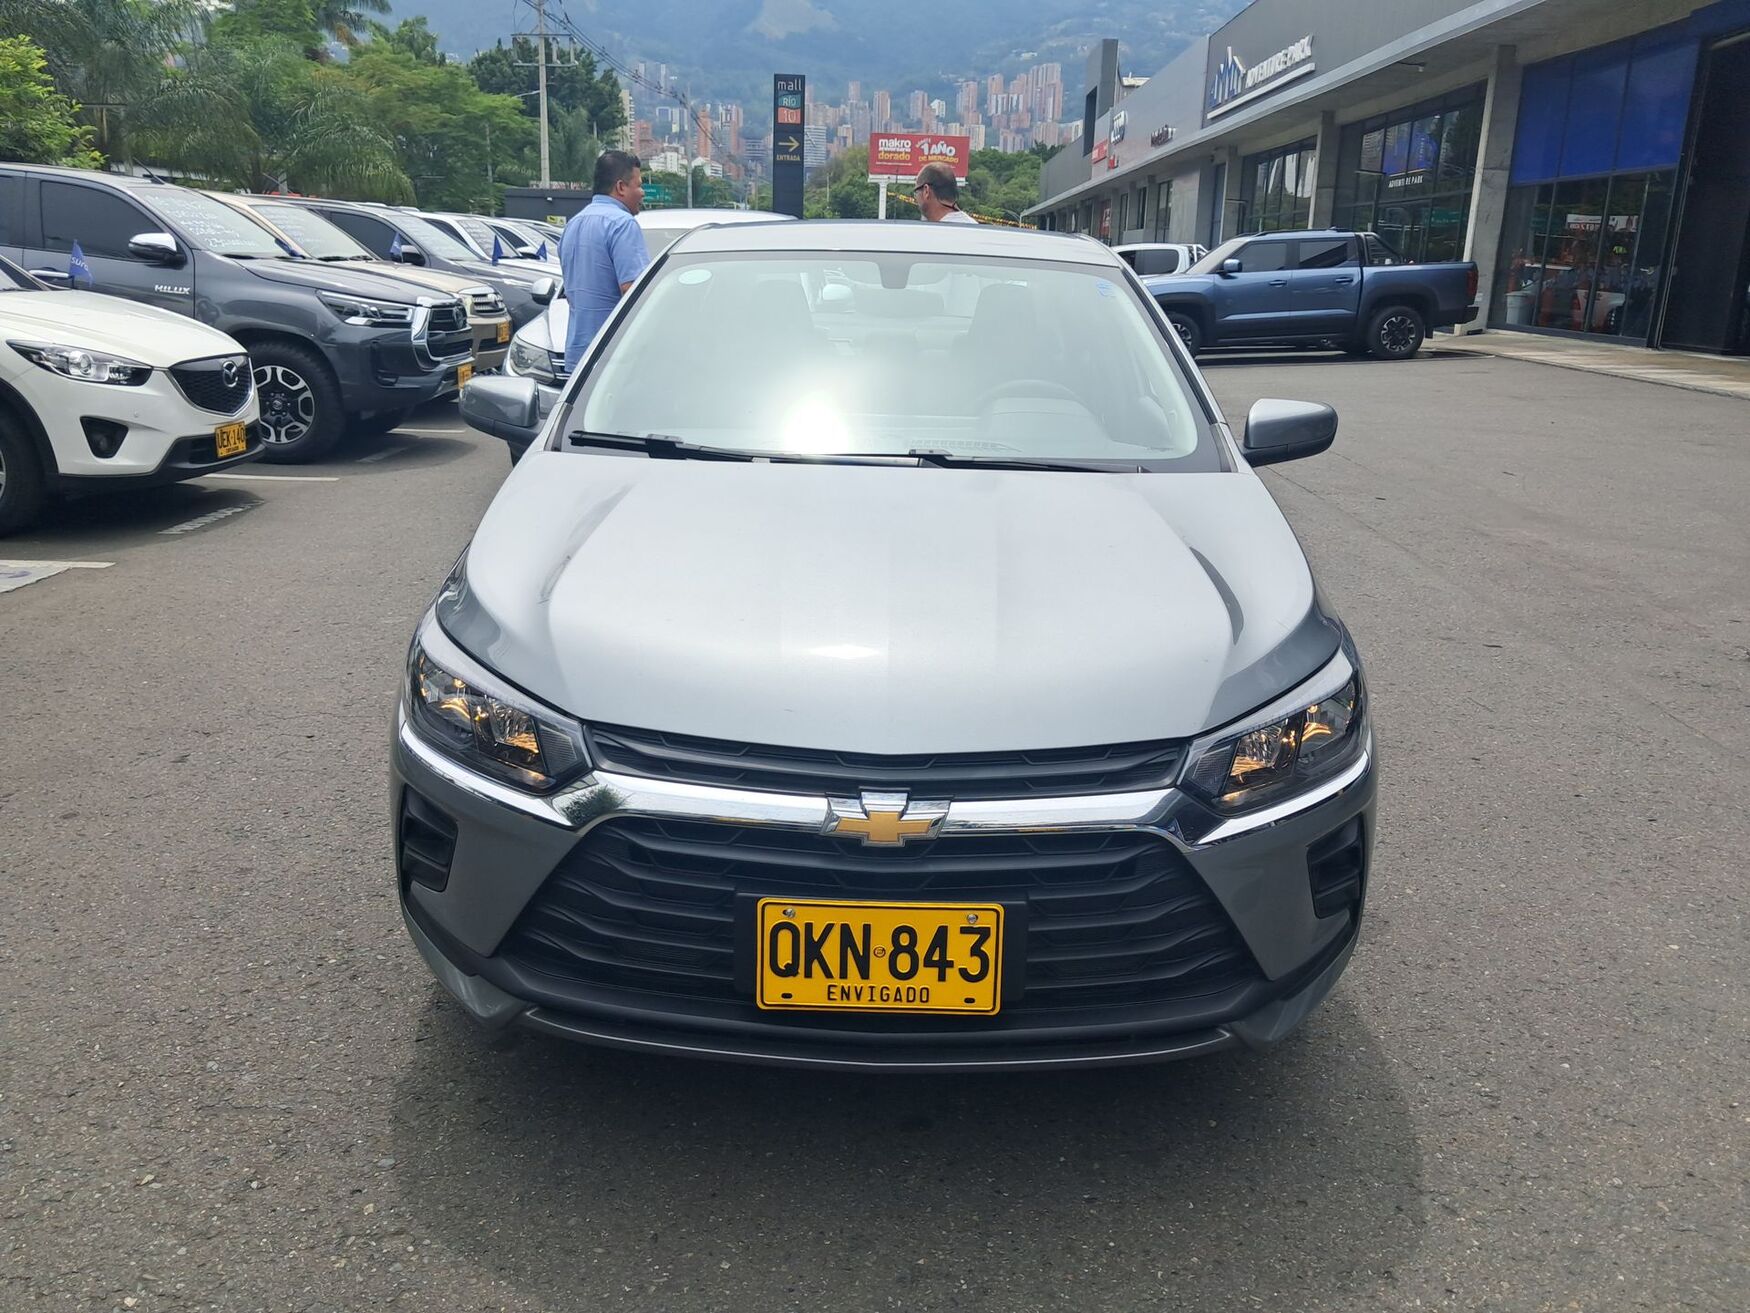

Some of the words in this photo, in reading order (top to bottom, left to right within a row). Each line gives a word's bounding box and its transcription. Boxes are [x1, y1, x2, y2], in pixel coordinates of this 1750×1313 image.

[777, 78, 802, 91] mall
[782, 96, 797, 107] RÍO
[783, 110, 797, 123] 10
[878, 138, 912, 148] makro
[919, 142, 929, 155] 1
[930, 140, 956, 156] AÑO
[878, 151, 911, 161] dorado
[928, 155, 959, 164] MERCADO
[154, 284, 191, 295] HILUX
[769, 921, 872, 980] QKN
[888, 924, 991, 983] 843
[827, 984, 930, 1004] ENVIGADO
